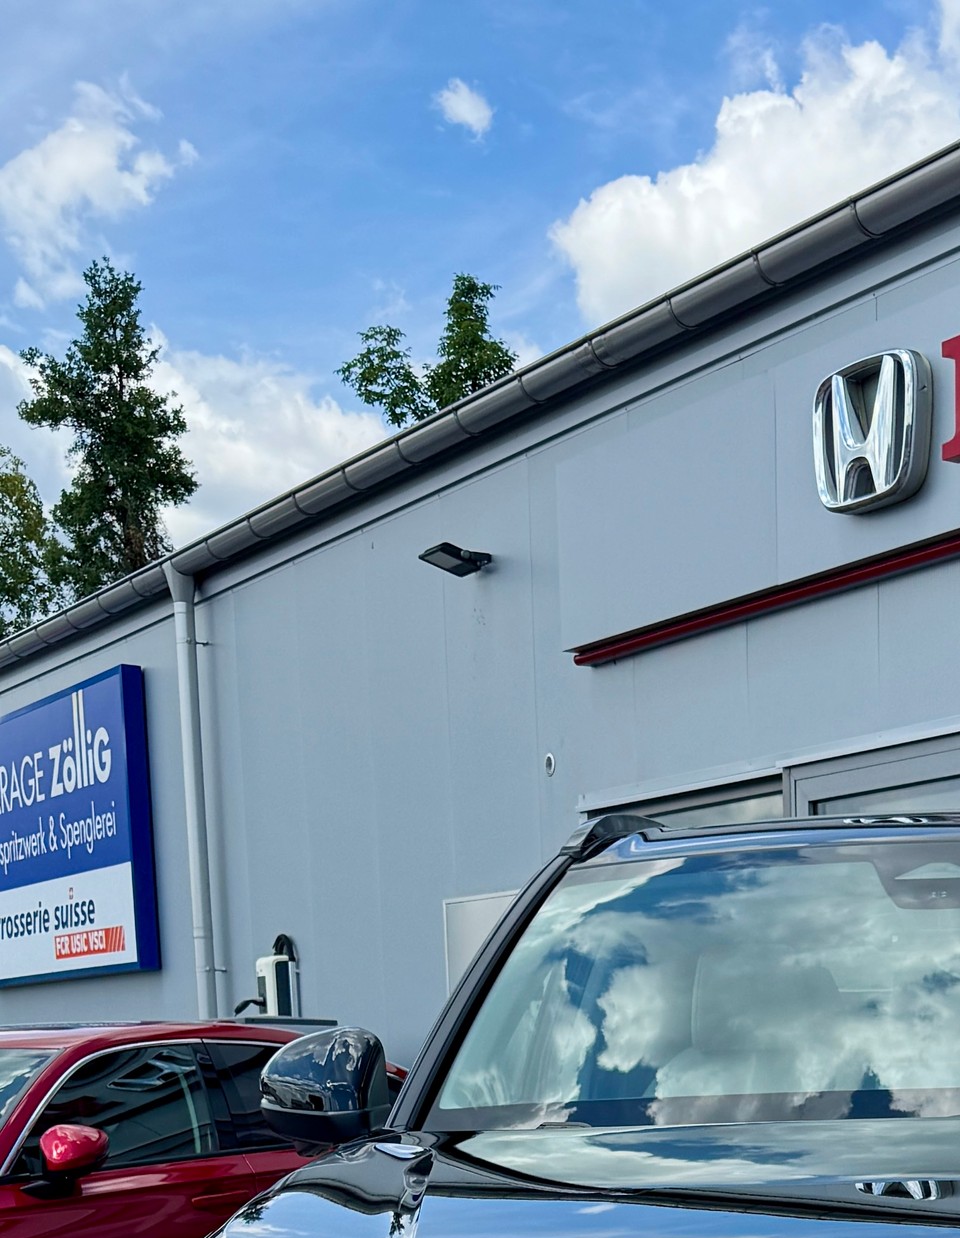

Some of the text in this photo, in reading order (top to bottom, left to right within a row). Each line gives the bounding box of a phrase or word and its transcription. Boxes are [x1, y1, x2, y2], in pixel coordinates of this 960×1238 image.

[0, 751, 44, 815] RAGE
[49, 815, 58, 851] &
[59, 801, 116, 859] Spenglerei
[0, 887, 96, 940] rosserie suisse
